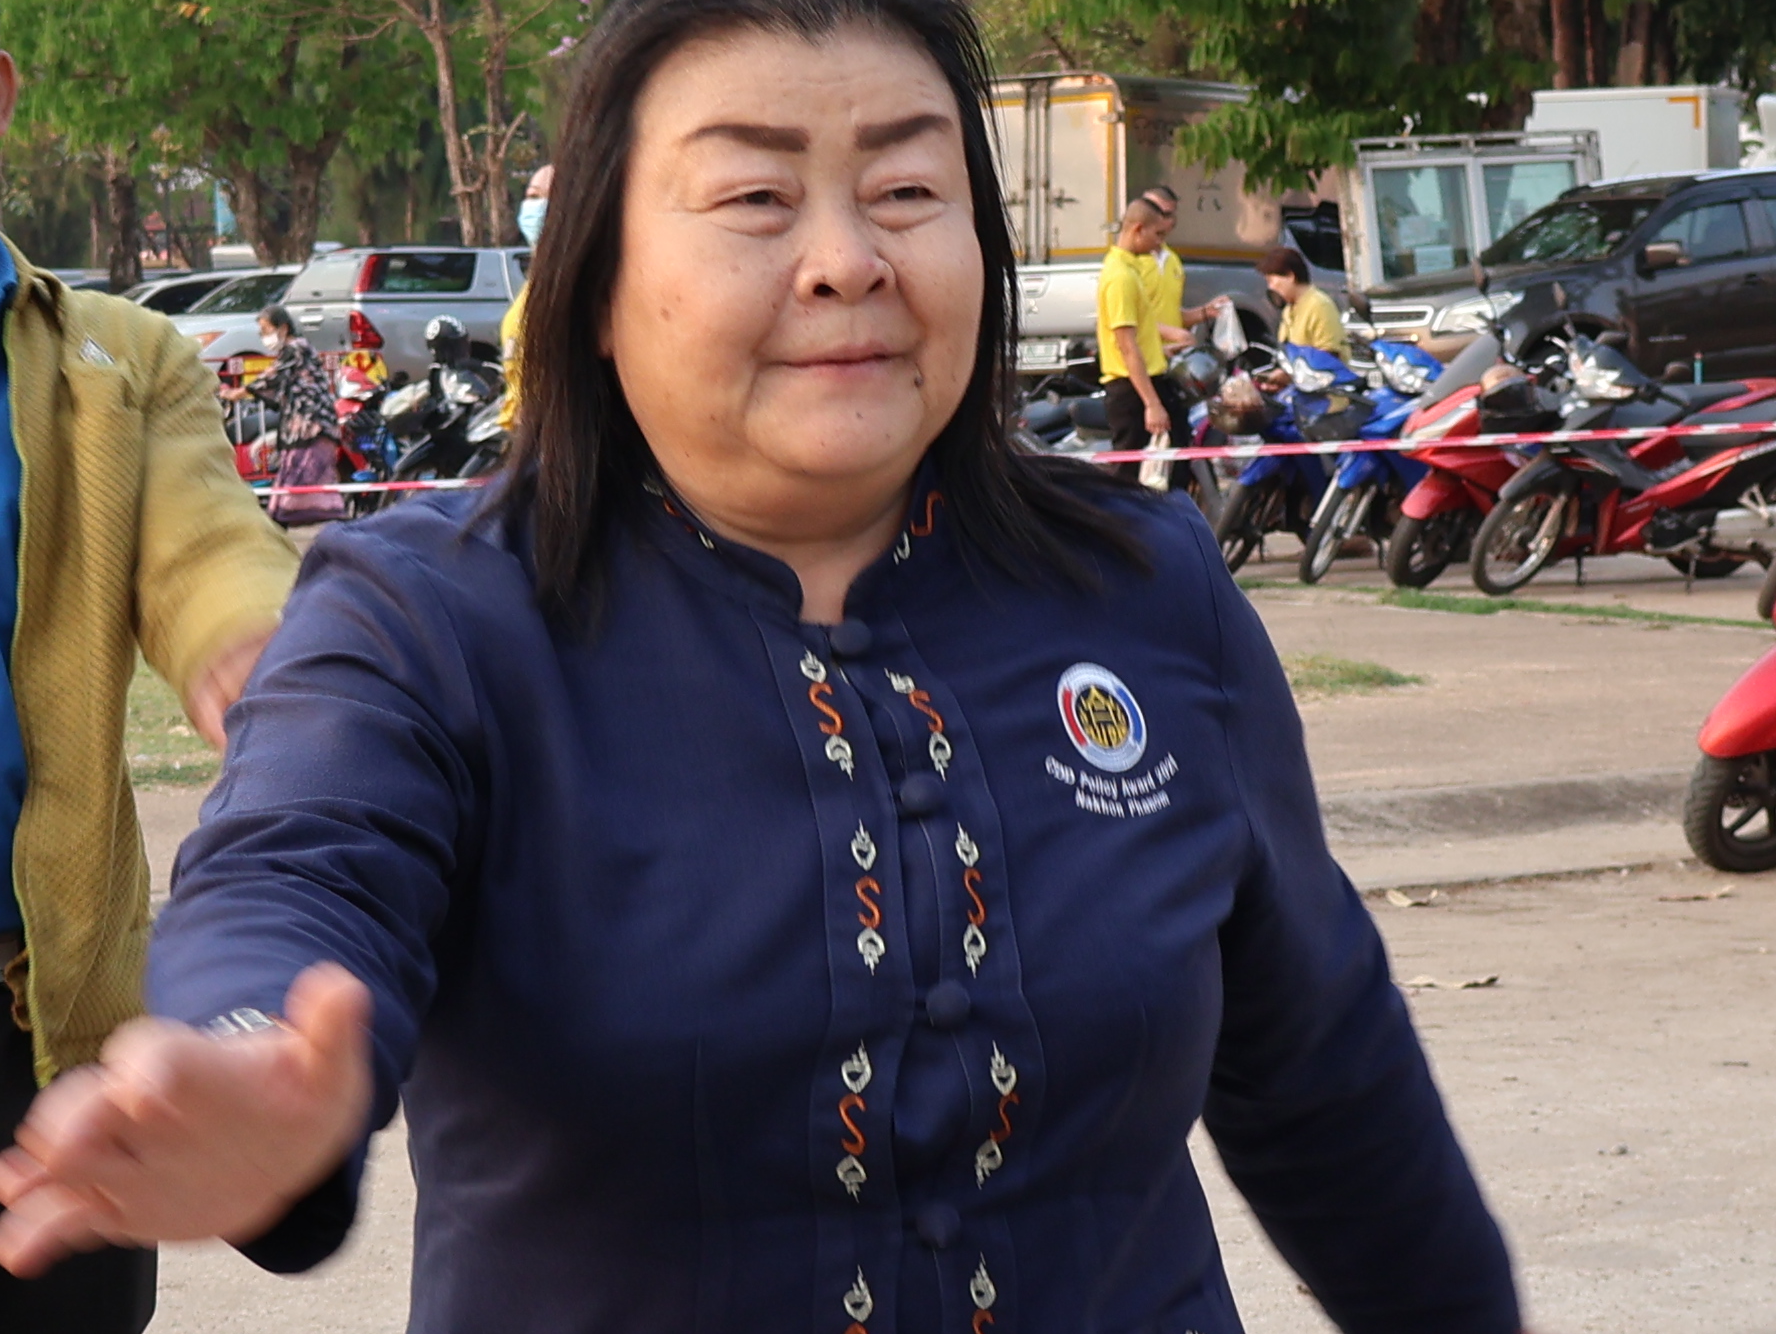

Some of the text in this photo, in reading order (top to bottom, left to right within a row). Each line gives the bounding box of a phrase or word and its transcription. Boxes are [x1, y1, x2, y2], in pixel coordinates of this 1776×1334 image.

[1121, 770, 1157, 798] Award
[1074, 786, 1171, 819] Nakhon Phanom
